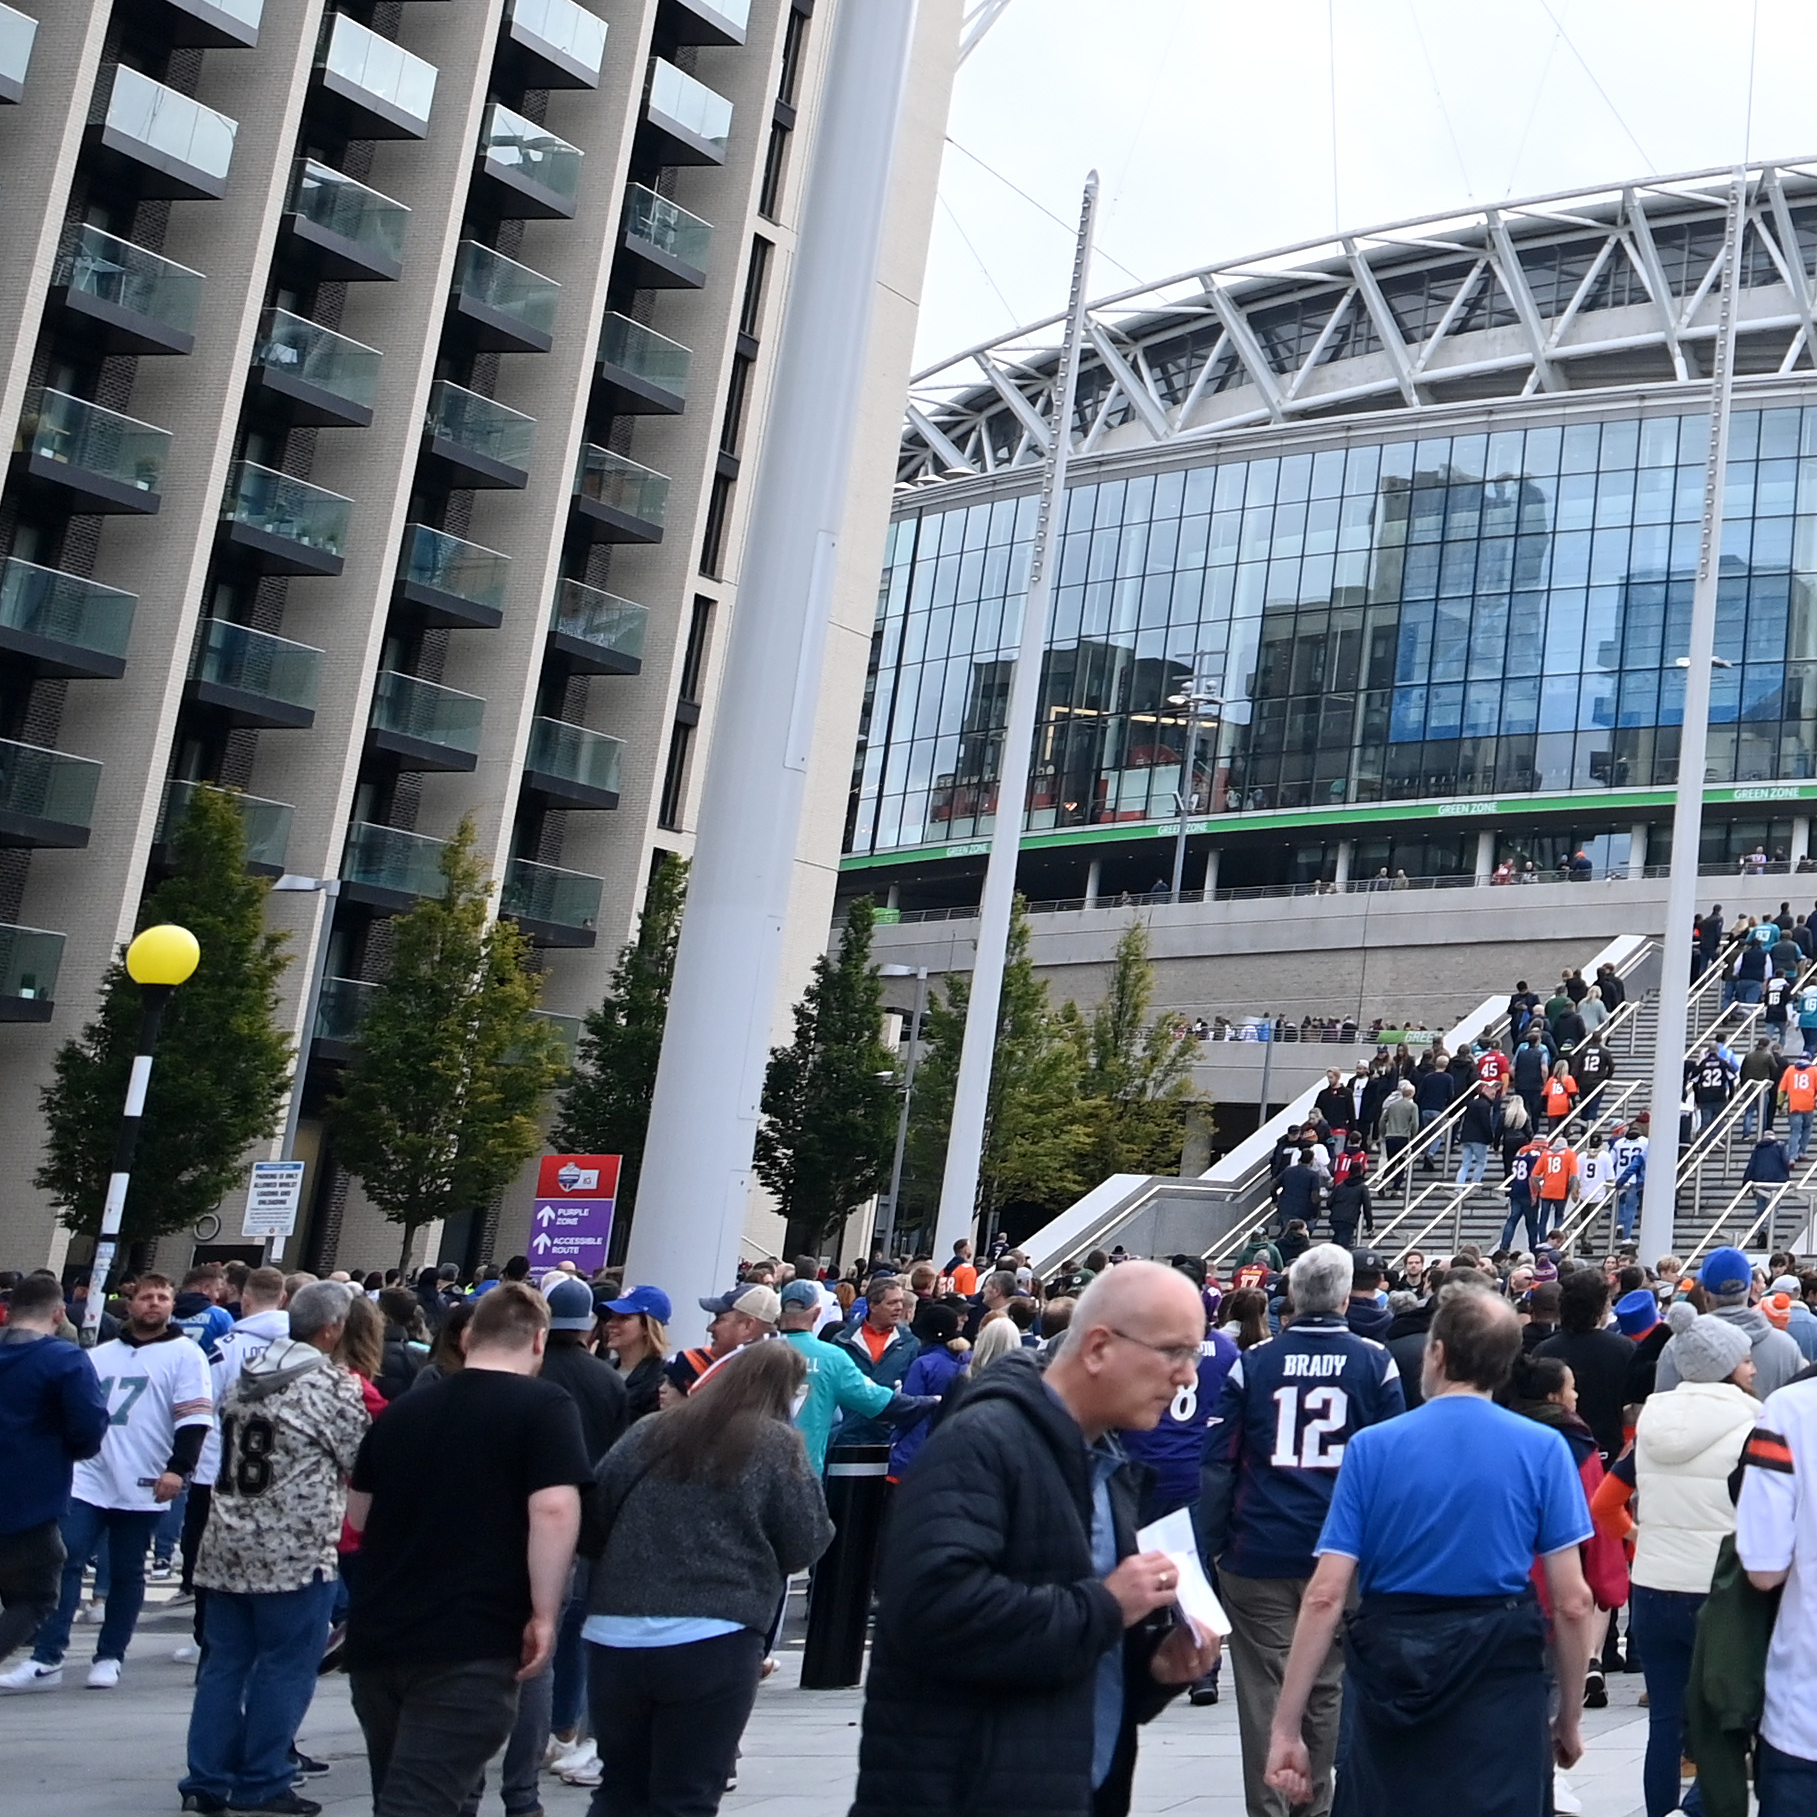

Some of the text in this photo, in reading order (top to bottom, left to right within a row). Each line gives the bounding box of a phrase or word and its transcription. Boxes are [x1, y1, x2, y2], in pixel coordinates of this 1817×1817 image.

[1733, 786, 1800, 800] GREEN ZONE
[1438, 802, 1498, 815] GREEN ZONE
[947, 843, 988, 856] GREEN ZONE
[1481, 1062, 1498, 1078] 45
[1584, 1055, 1600, 1072] 12
[1702, 1068, 1722, 1087] 32
[1793, 1073, 1810, 1090] 18
[1547, 1156, 1561, 1174] 18
[1586, 1162, 1596, 1179] 9
[557, 1208, 590, 1216] PURPLE
[553, 1237, 604, 1245] ACCESSIBLE
[552, 1246, 580, 1254] ROUTE
[1282, 1354, 1347, 1377] BRADY
[1271, 1386, 1348, 1469] 12
[215, 1414, 275, 1498] 18
